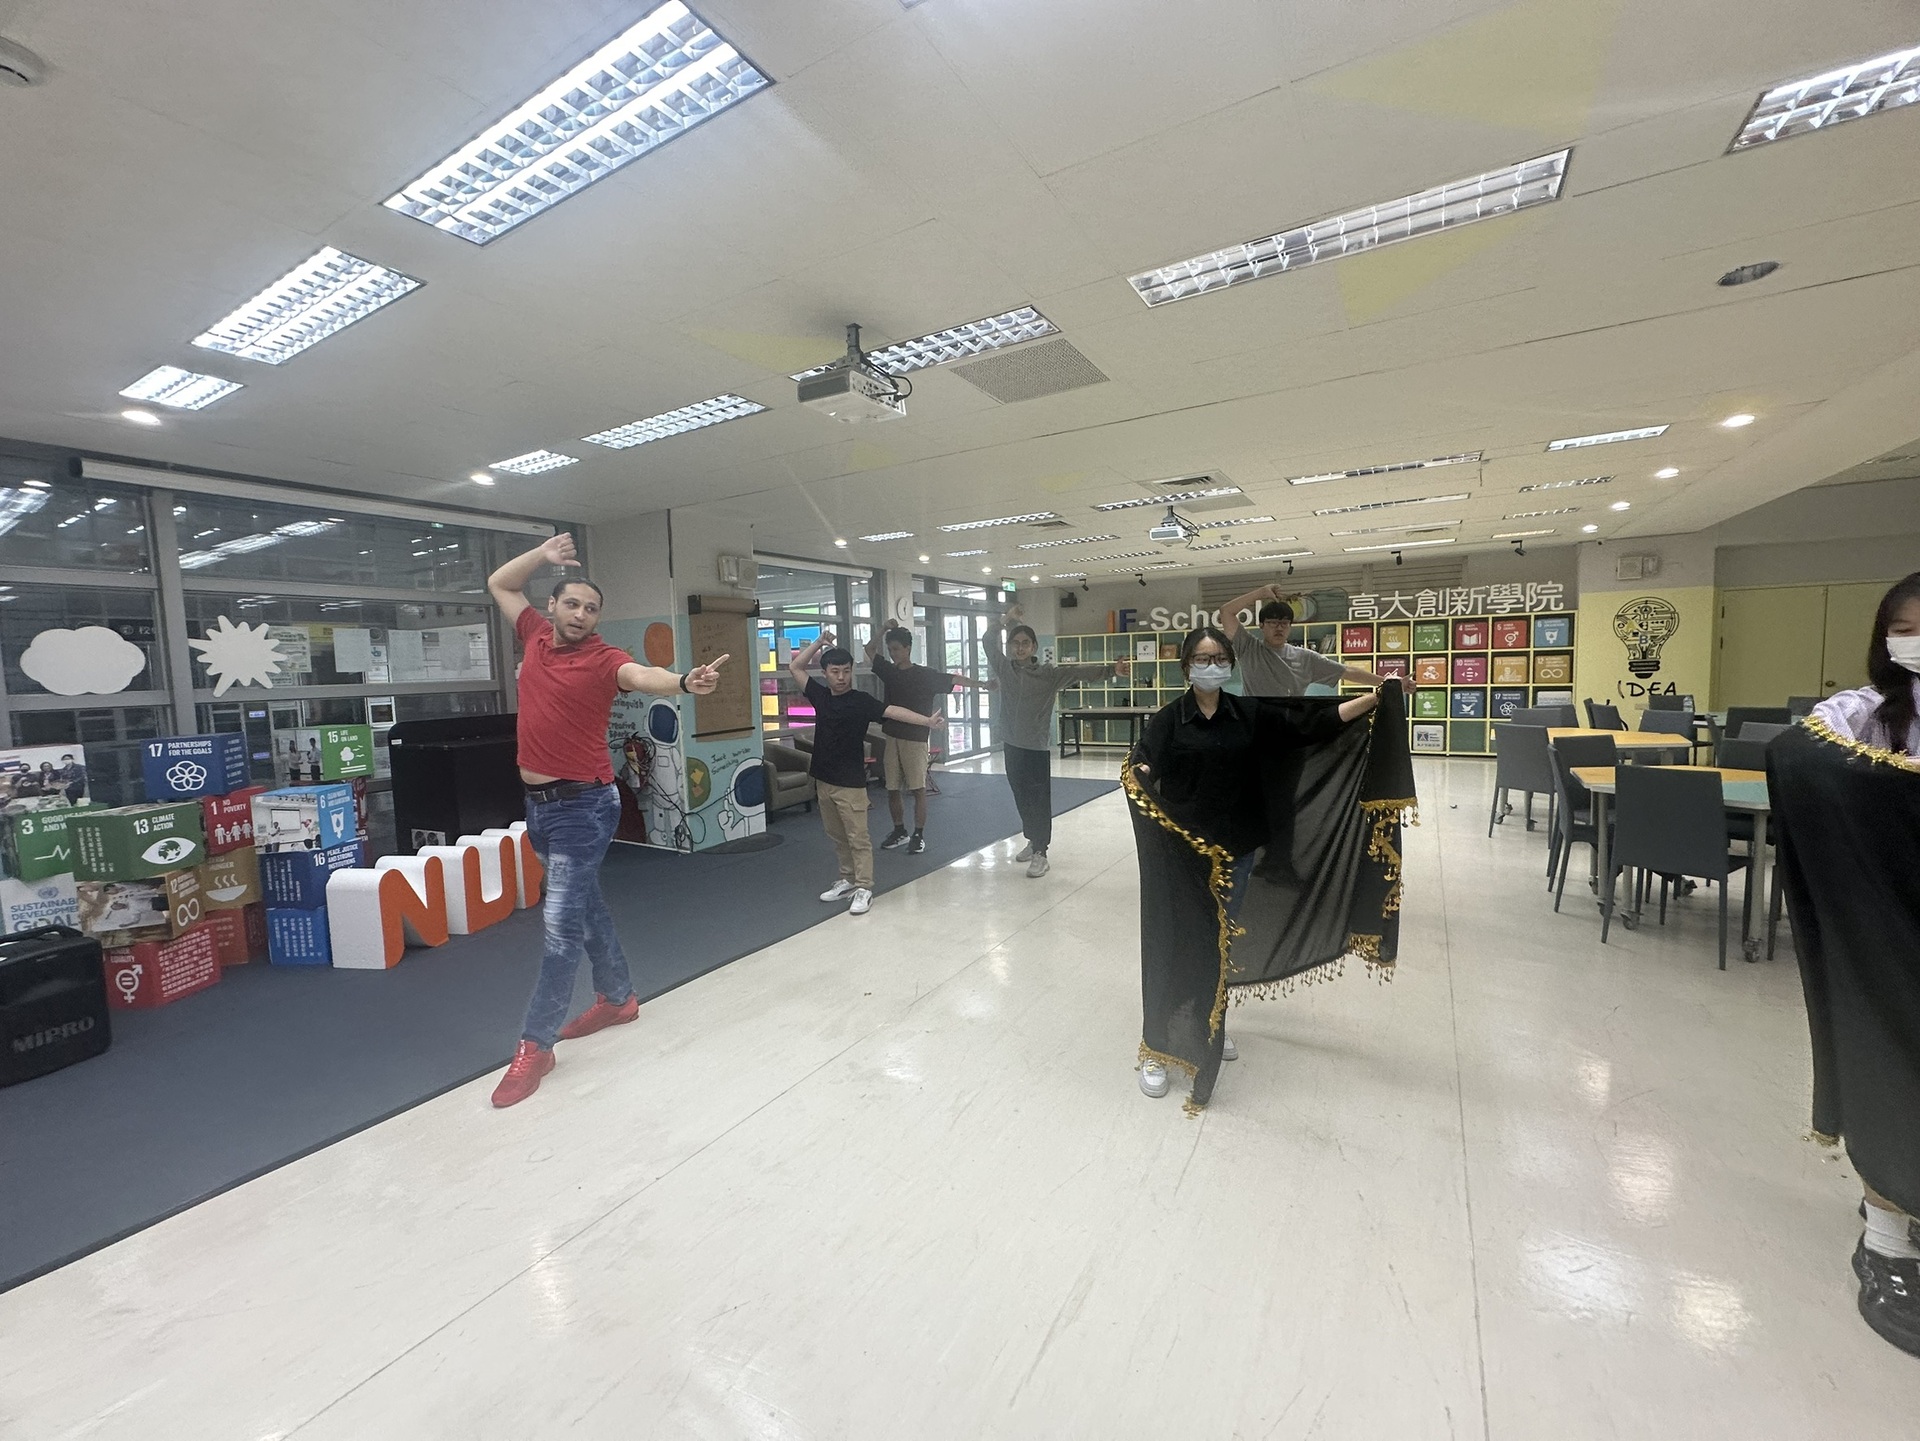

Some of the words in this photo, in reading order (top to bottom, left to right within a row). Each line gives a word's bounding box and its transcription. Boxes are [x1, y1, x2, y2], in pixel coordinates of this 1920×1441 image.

[1348, 581, 1564, 620] 高大創新學院
[327, 730, 339, 743] 15
[148, 743, 163, 757] 17
[168, 740, 212, 749] PARTNERSHIPS
[192, 747, 212, 755] GOALS
[211, 801, 217, 815] 1
[223, 803, 246, 813] POVERTY
[319, 795, 326, 809] 6
[21, 819, 34, 835] 3
[41, 814, 64, 824] GOOD
[43, 823, 60, 833] AND
[133, 818, 149, 835] 13
[152, 813, 175, 824] CLIMATE
[153, 821, 174, 832] ACTION
[313, 853, 326, 867] 16
[13, 913, 81, 933] GOAL
[12, 1016, 95, 1052] MIPRO
